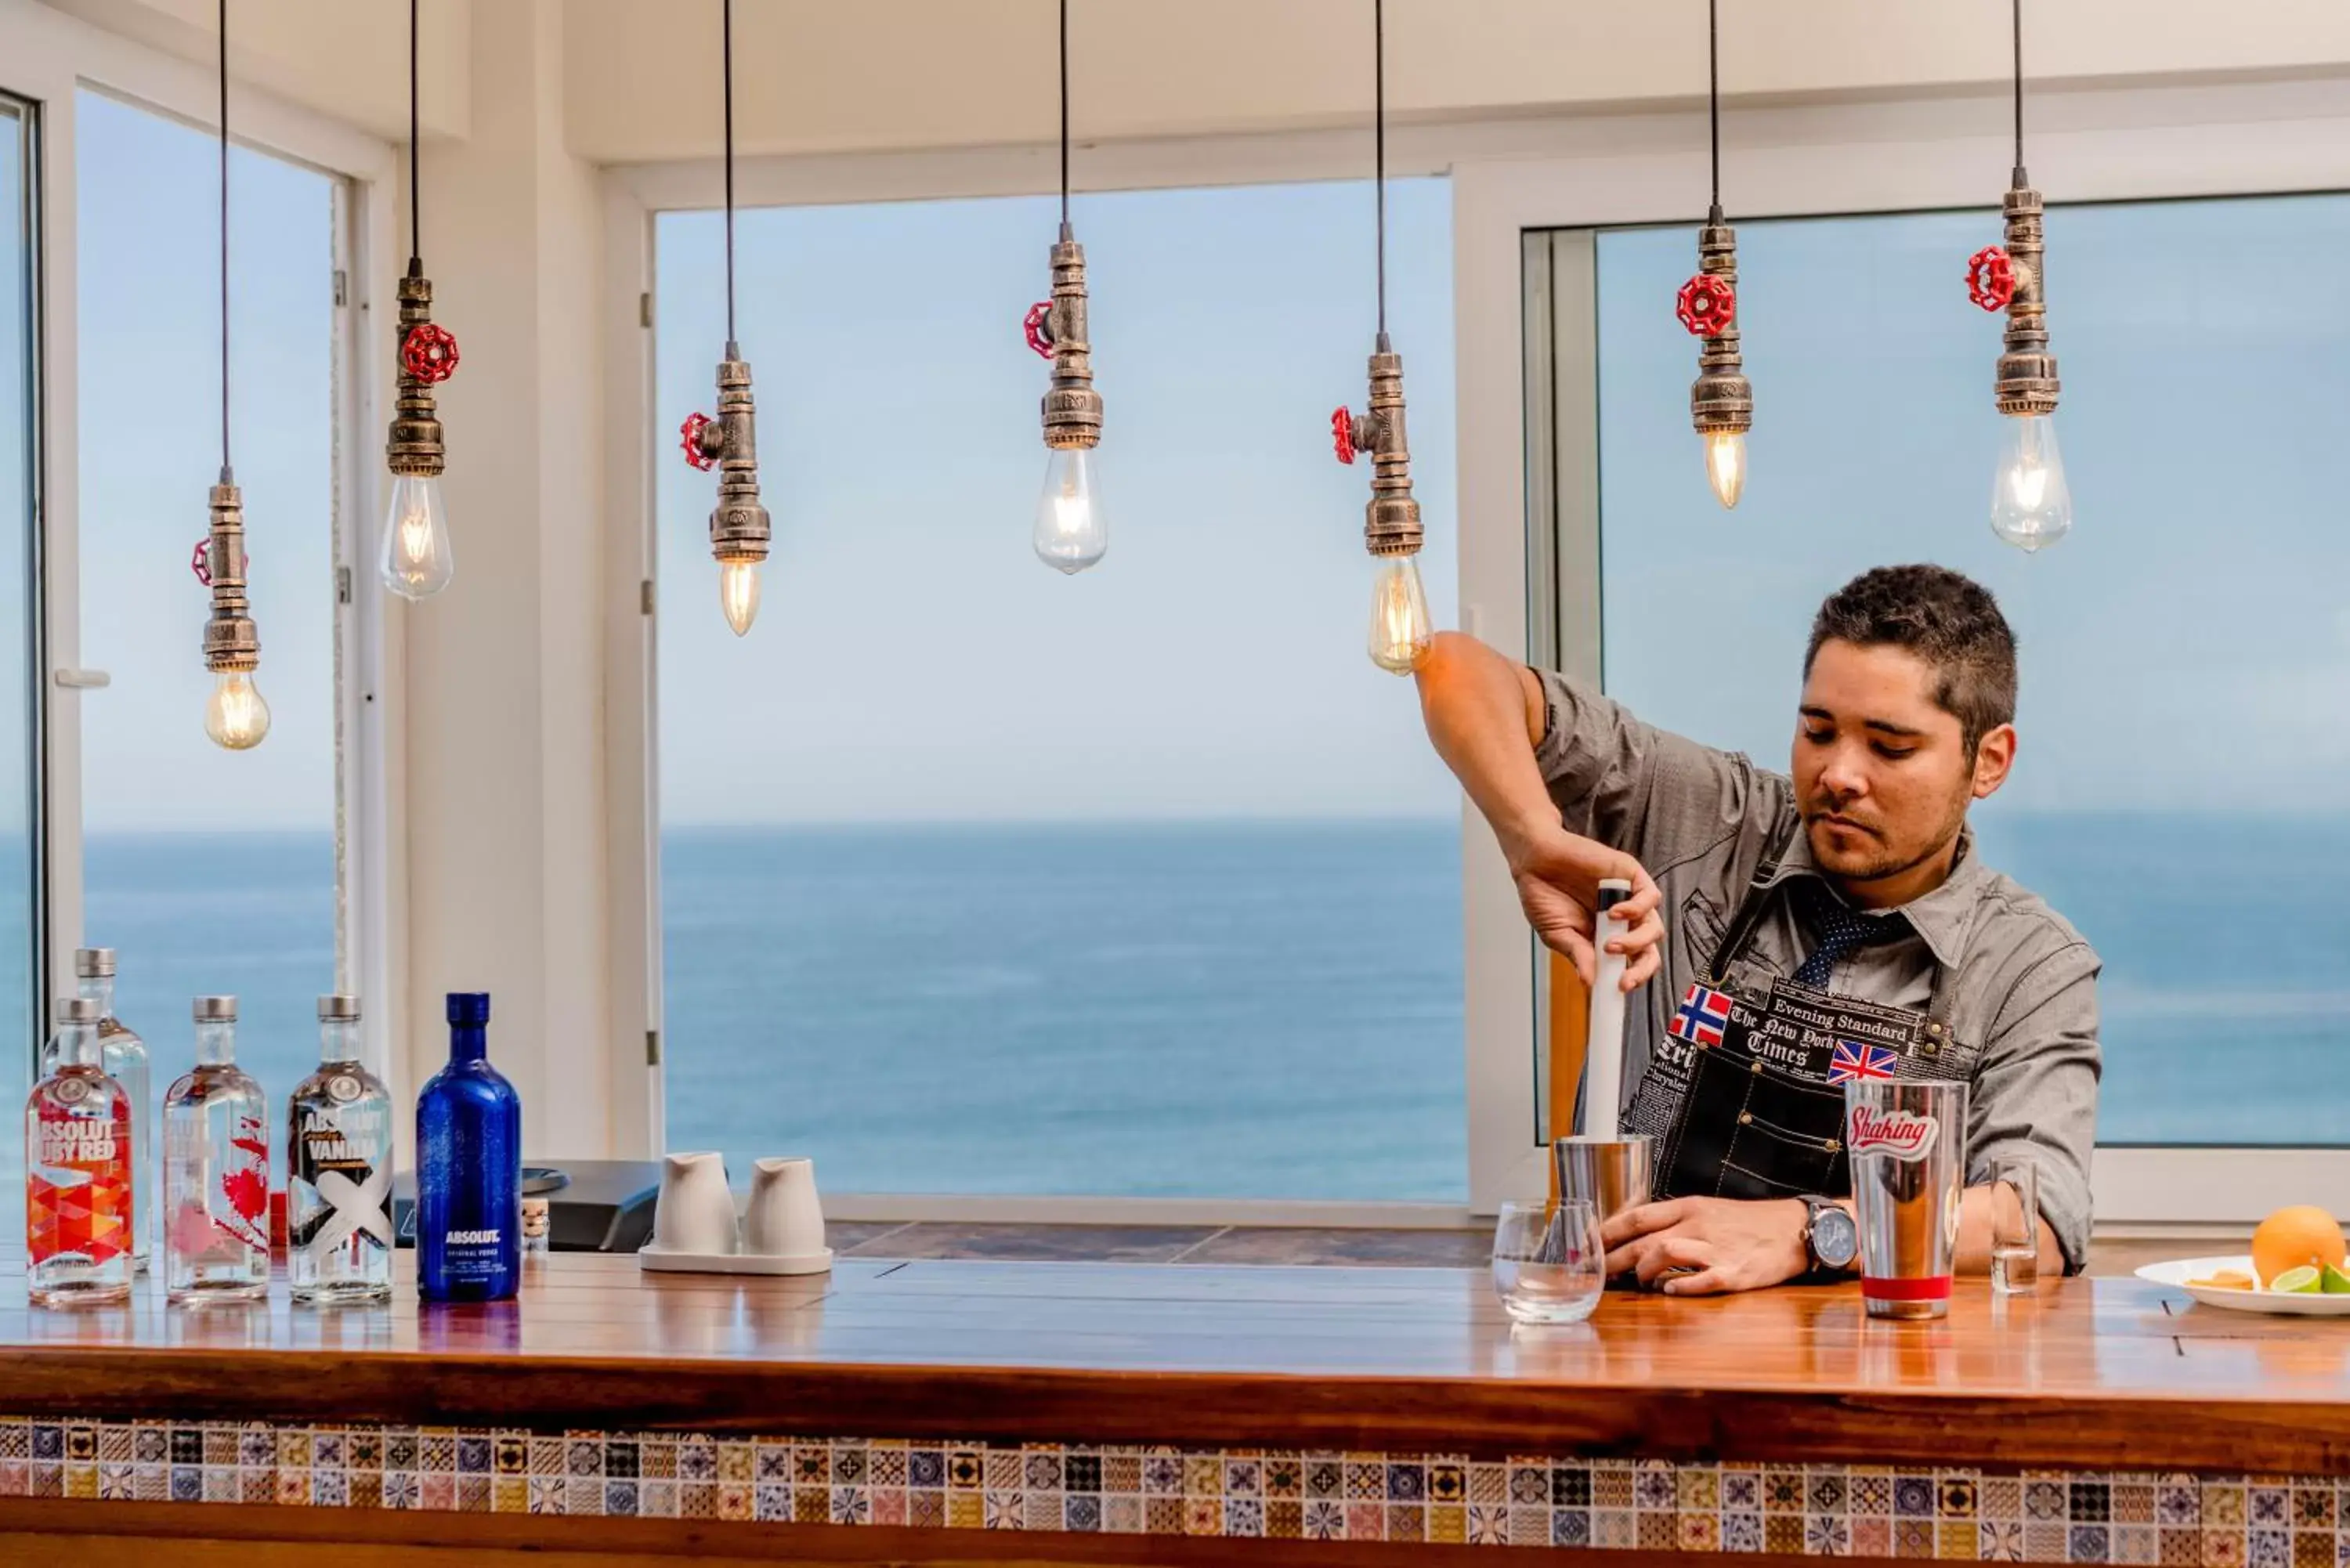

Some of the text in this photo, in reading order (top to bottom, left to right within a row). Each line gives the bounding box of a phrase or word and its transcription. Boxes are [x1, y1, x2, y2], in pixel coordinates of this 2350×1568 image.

[1730, 1006, 1835, 1050] The New York
[1774, 998, 1835, 1030] Evening
[1837, 1015, 1907, 1042] Standard
[1747, 1030, 1810, 1068] Times
[1849, 1105, 1928, 1149] Shaking
[79, 1140, 117, 1161] RED
